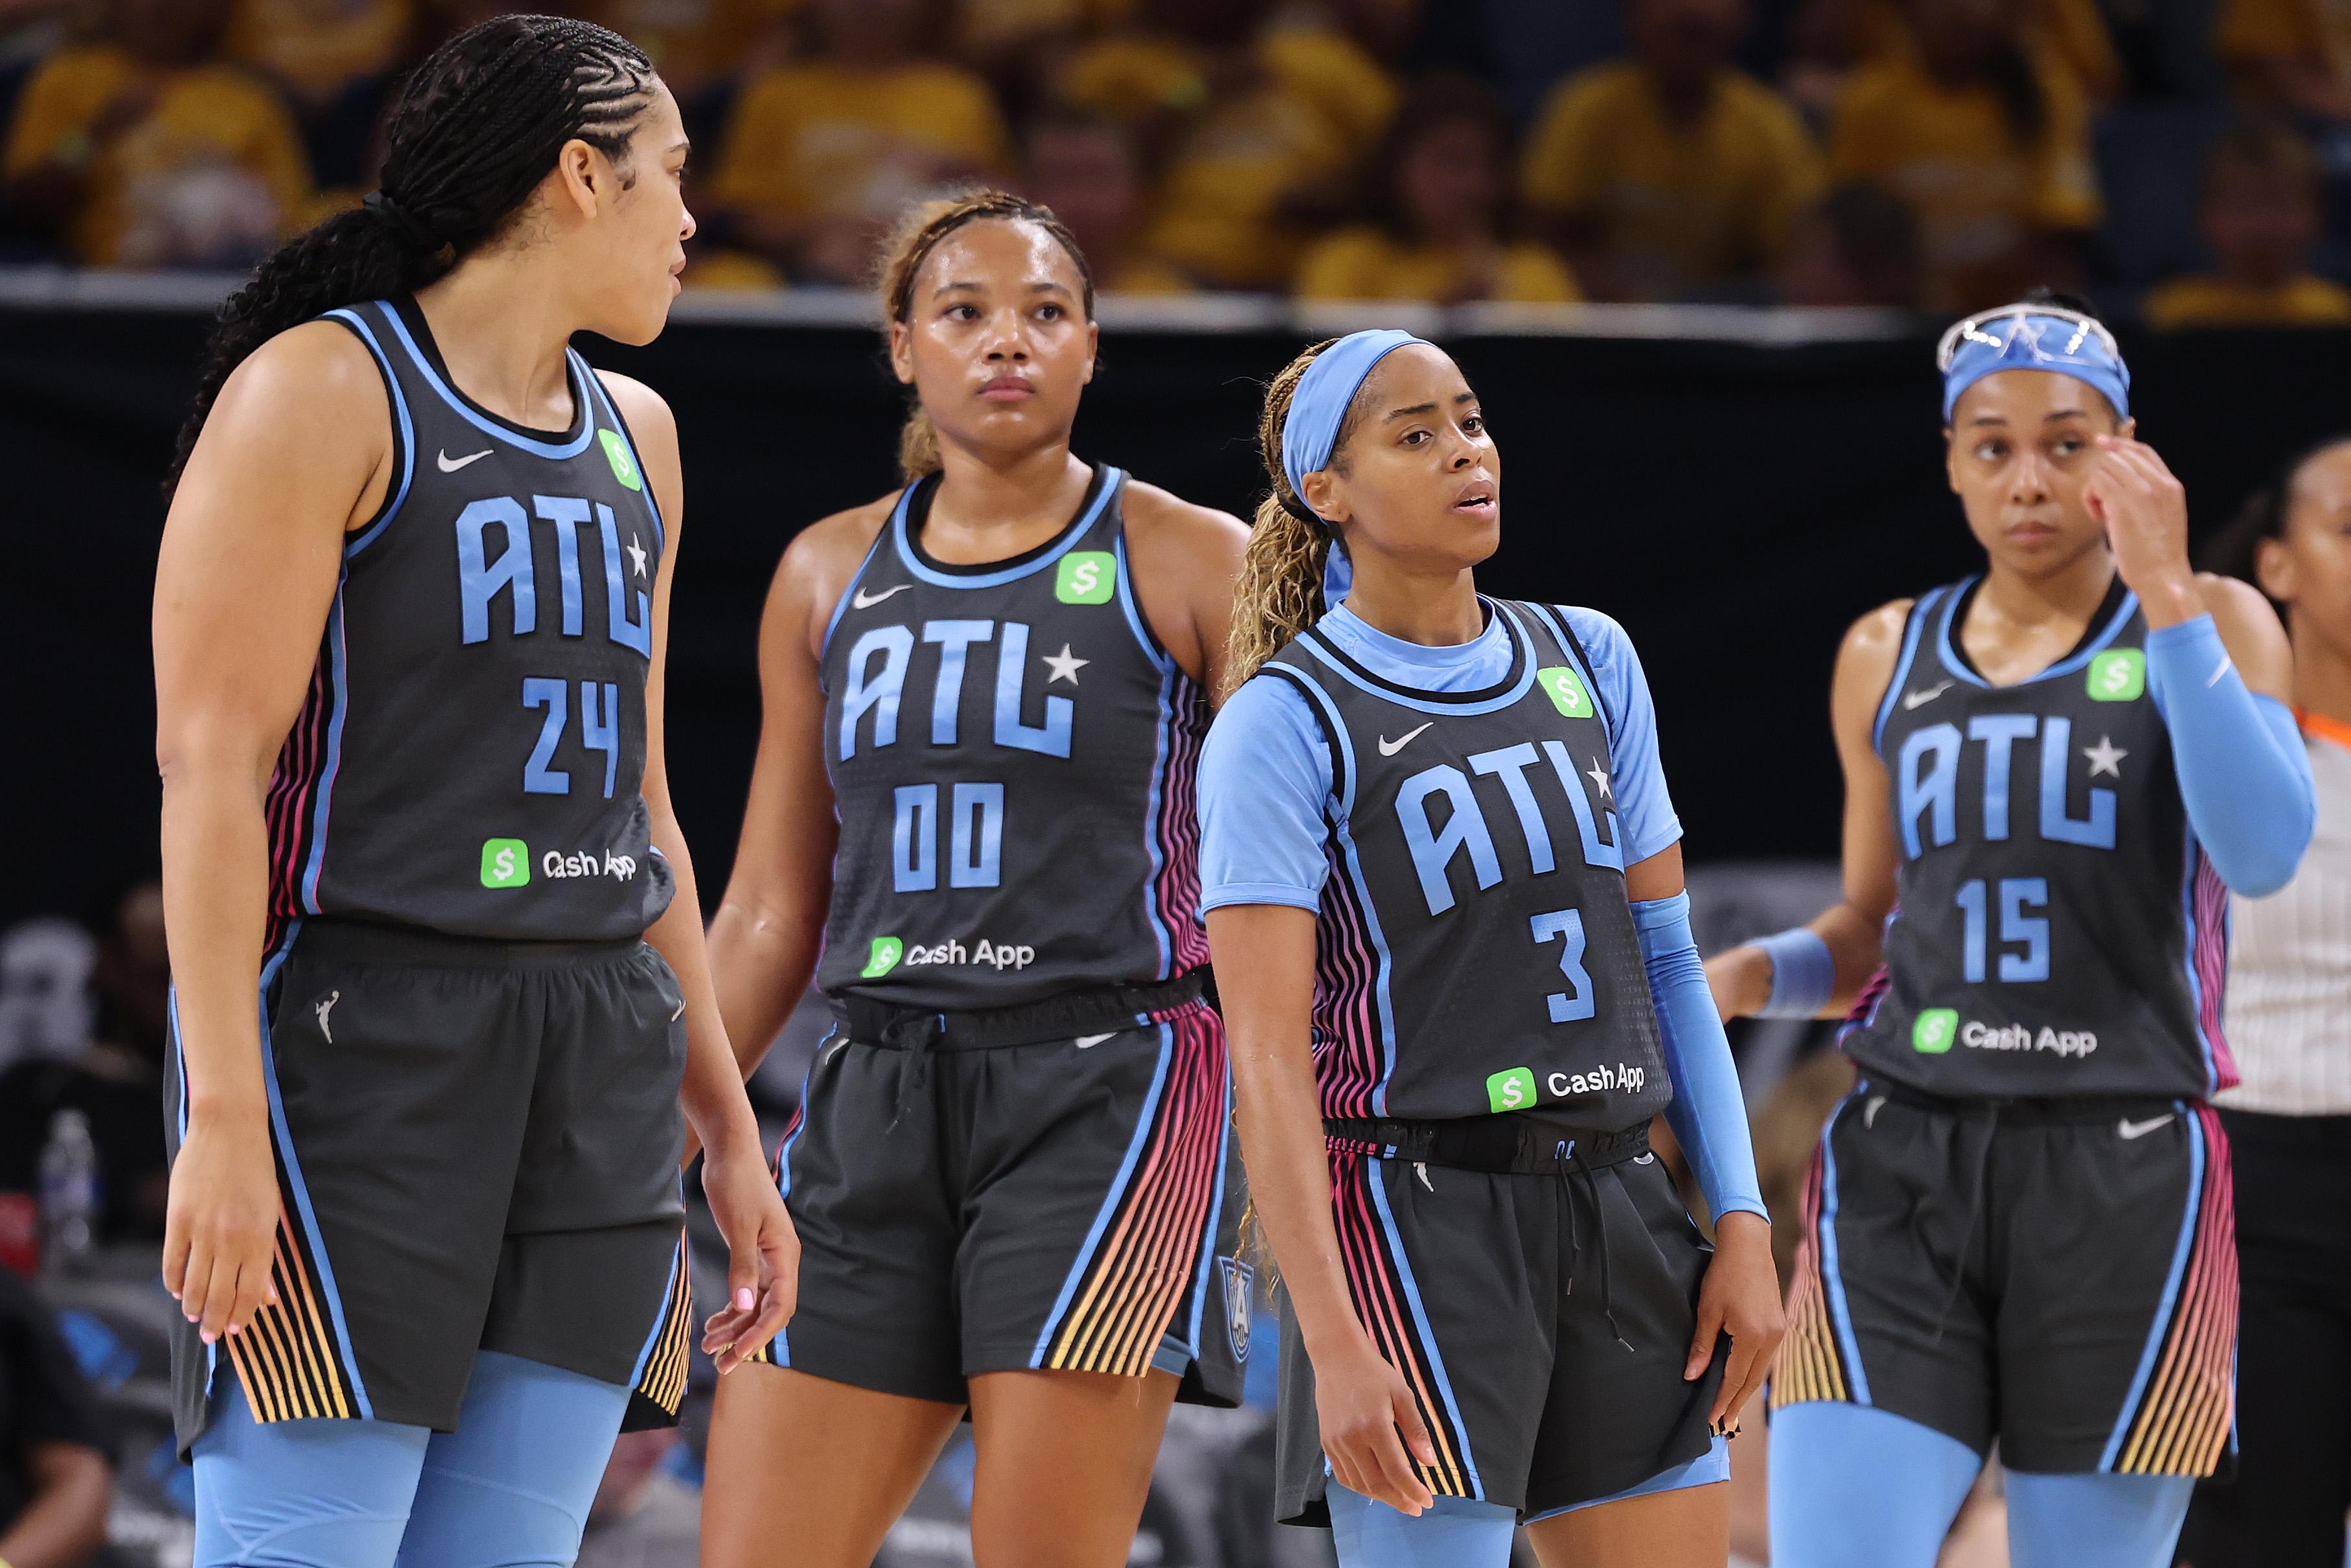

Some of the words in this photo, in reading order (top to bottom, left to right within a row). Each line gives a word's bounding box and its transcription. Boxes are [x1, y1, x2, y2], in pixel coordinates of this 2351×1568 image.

[455, 494, 651, 660] ATL
[523, 677, 620, 799] 24
[841, 620, 1074, 762] ATL
[894, 783, 1004, 893] 00
[1395, 740, 1626, 917] ATL
[1898, 714, 2117, 861] ATL
[542, 850, 599, 880] Cash
[603, 848, 636, 882] App
[906, 938, 967, 967] Cash
[973, 938, 1036, 970] App
[1530, 908, 1595, 1023] 3
[1956, 877, 2050, 983] 15
[1548, 1065, 1615, 1097] Cash
[1616, 1062, 1645, 1094] App
[1961, 1020, 2031, 1052] Cash
[2036, 1026, 2098, 1059] App
